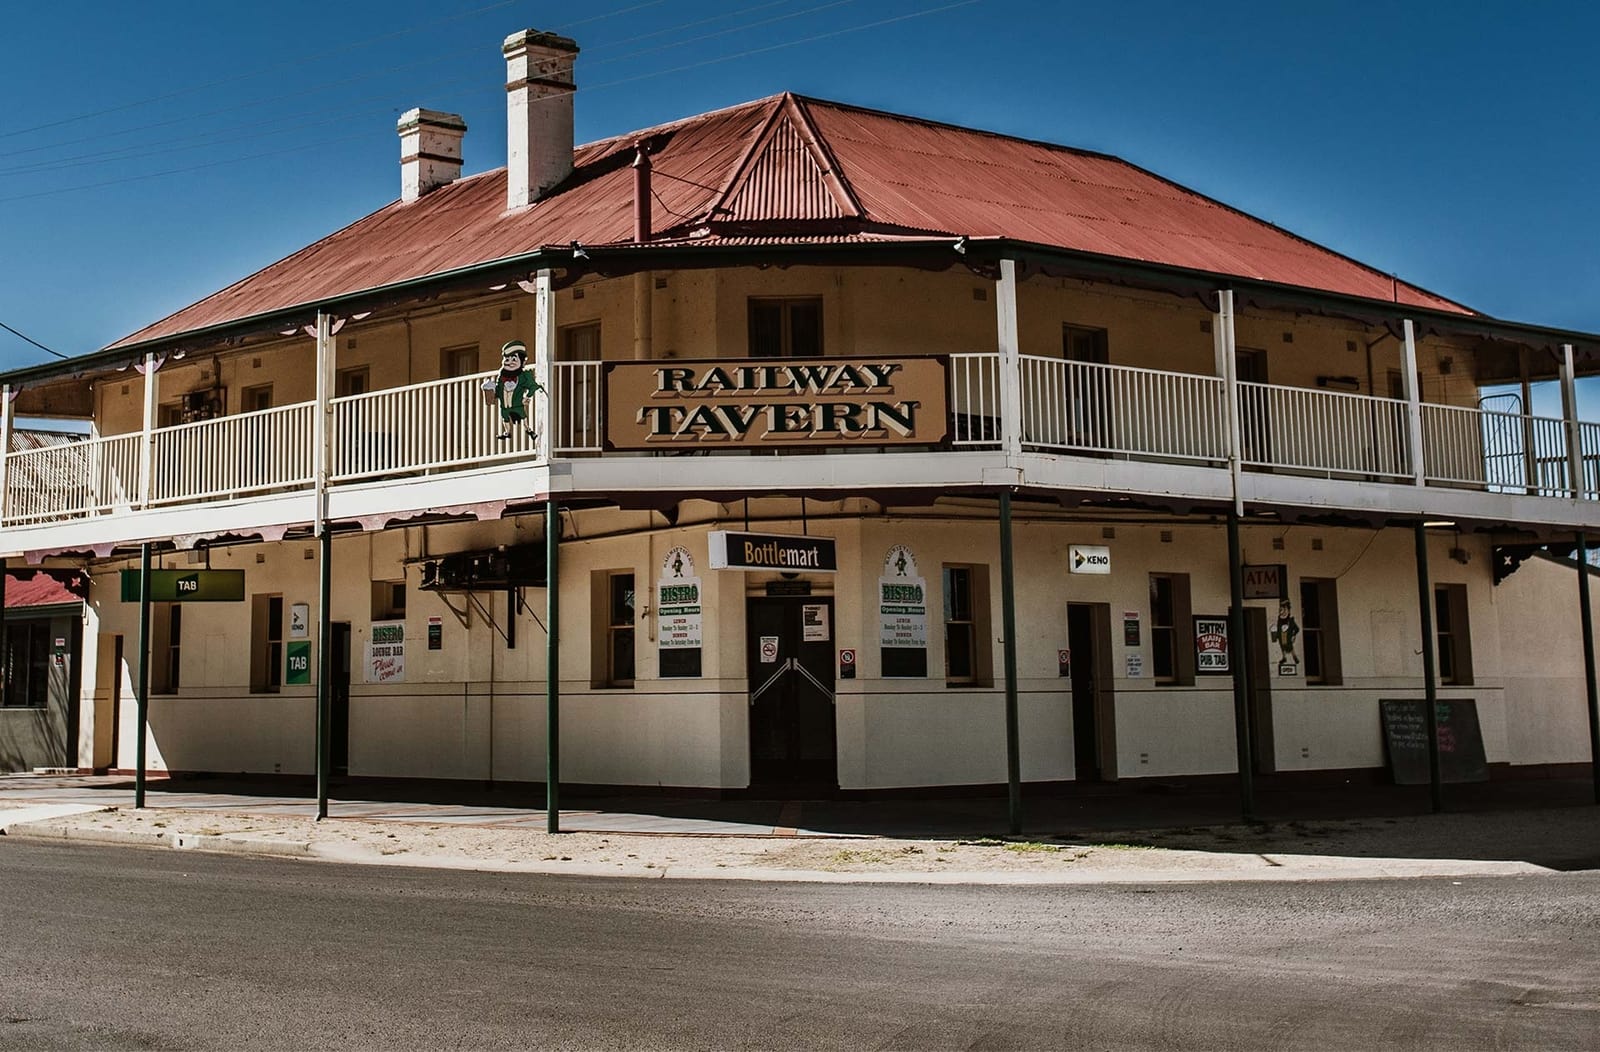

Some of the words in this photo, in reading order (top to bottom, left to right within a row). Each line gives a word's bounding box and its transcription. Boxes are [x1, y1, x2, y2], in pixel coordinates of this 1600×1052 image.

[651, 364, 902, 399] RAILWAY
[636, 400, 921, 441] TAVERN
[744, 541, 820, 567] Bottlemart
[1087, 556, 1108, 565] KENO
[1246, 571, 1277, 585] ATM
[178, 581, 197, 591] TAB
[660, 584, 698, 605] BISTRO
[882, 583, 923, 604] BISTRO
[372, 624, 404, 645] BISTRO
[1199, 622, 1225, 635] ENTRY
[1201, 635, 1222, 643] MAIN
[290, 656, 307, 670] TAB
[1200, 654, 1213, 666] PUB
[1214, 654, 1227, 665] TAB
